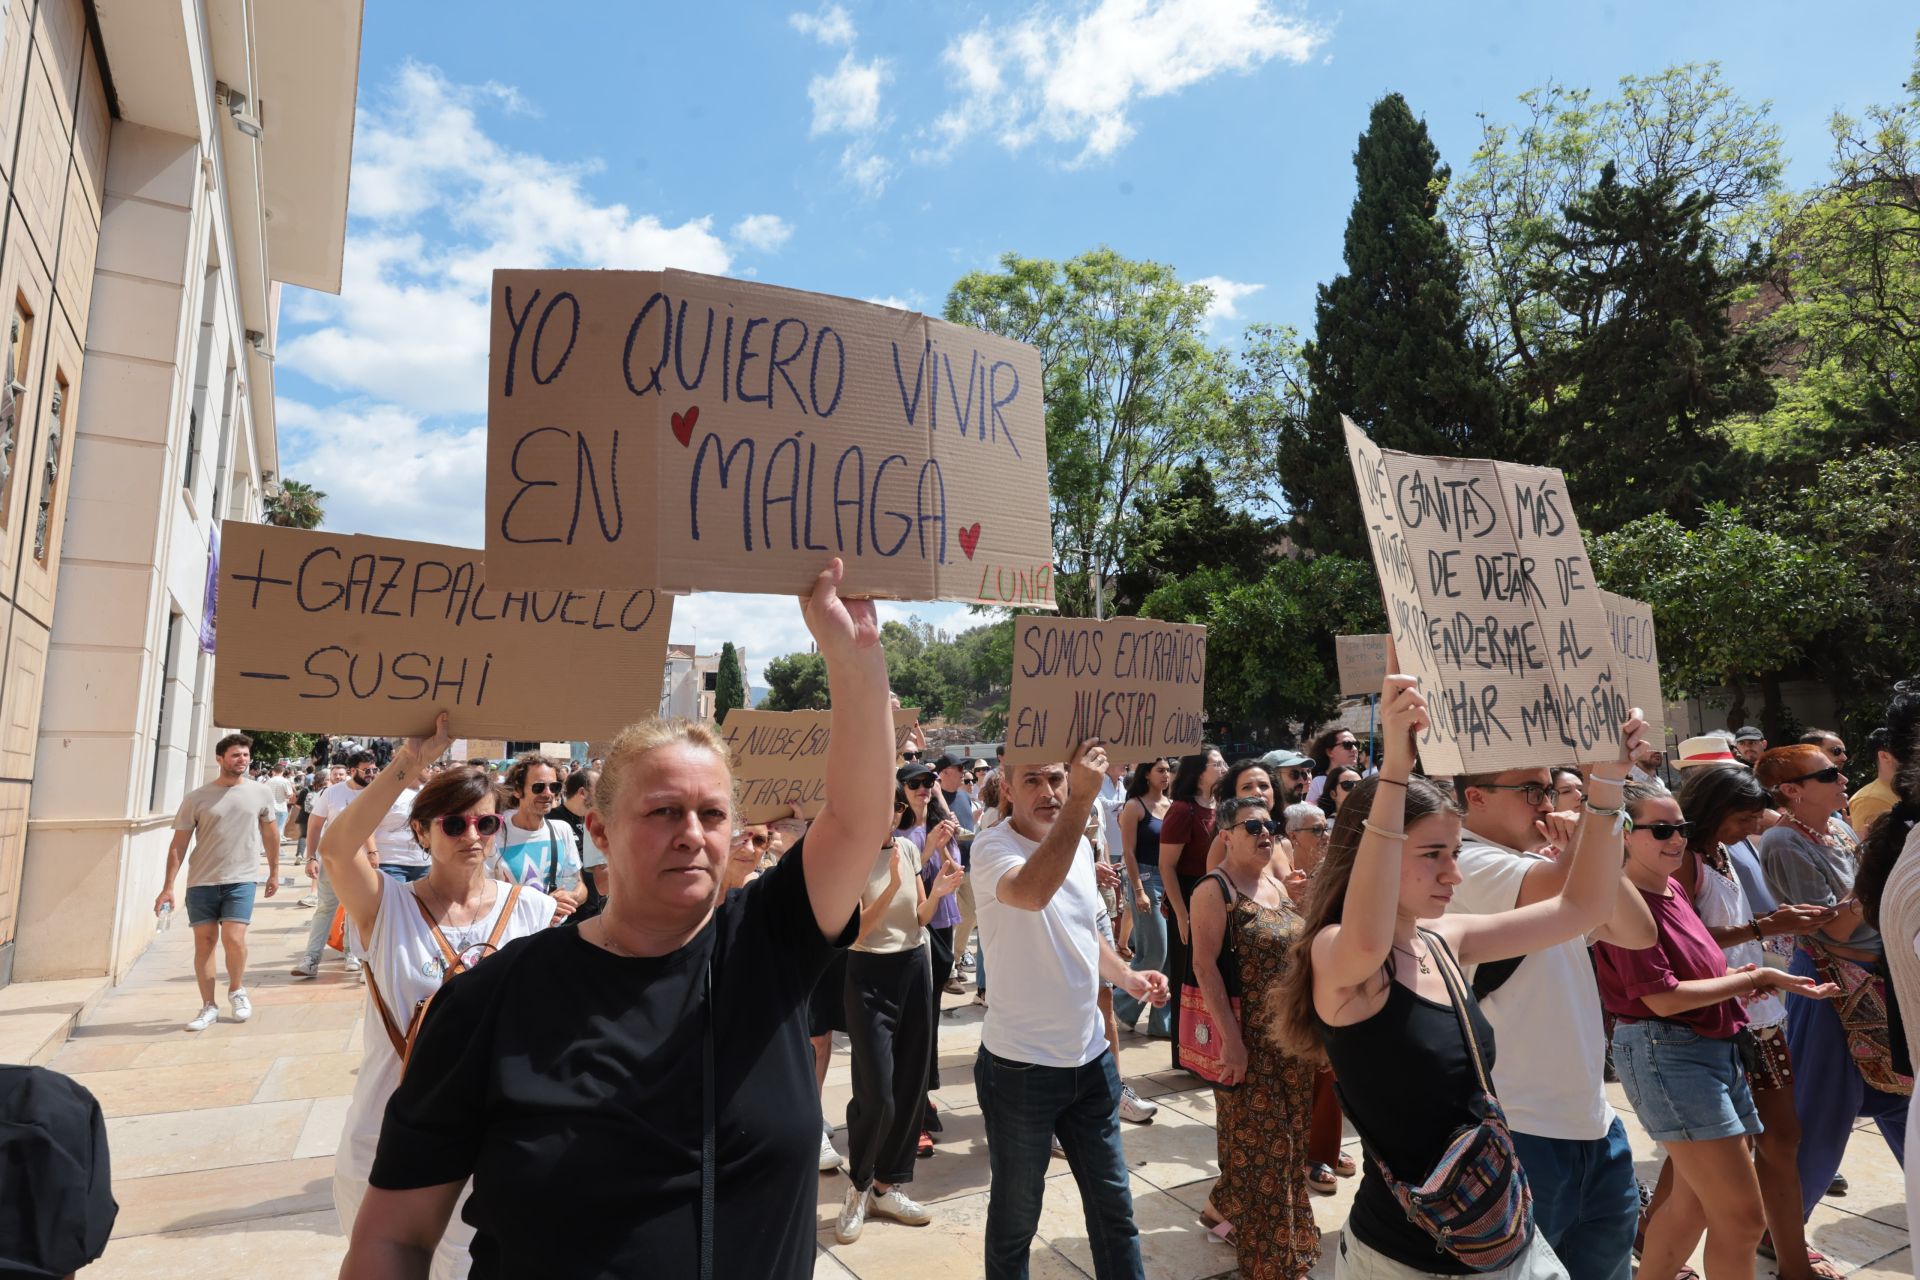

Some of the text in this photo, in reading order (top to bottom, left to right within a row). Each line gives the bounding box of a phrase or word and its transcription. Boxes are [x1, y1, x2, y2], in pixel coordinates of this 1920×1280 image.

[504, 285, 581, 397] YO
[501, 426, 623, 546] EN
[1396, 468, 1497, 543] GANITAS
[1513, 479, 1566, 540] MÁS
[976, 562, 1052, 605] LUNA
[1428, 549, 1462, 599] DE
[1475, 551, 1548, 610] DEJAR
[1554, 556, 1586, 607] DE
[1020, 625, 1206, 685] SOMOS EXTRAÑAS
[1556, 617, 1593, 671] AL
[1013, 706, 1048, 748] EN
[1065, 687, 1157, 749] NUESTRA
[1520, 661, 1628, 751] MALAGUEÑO
